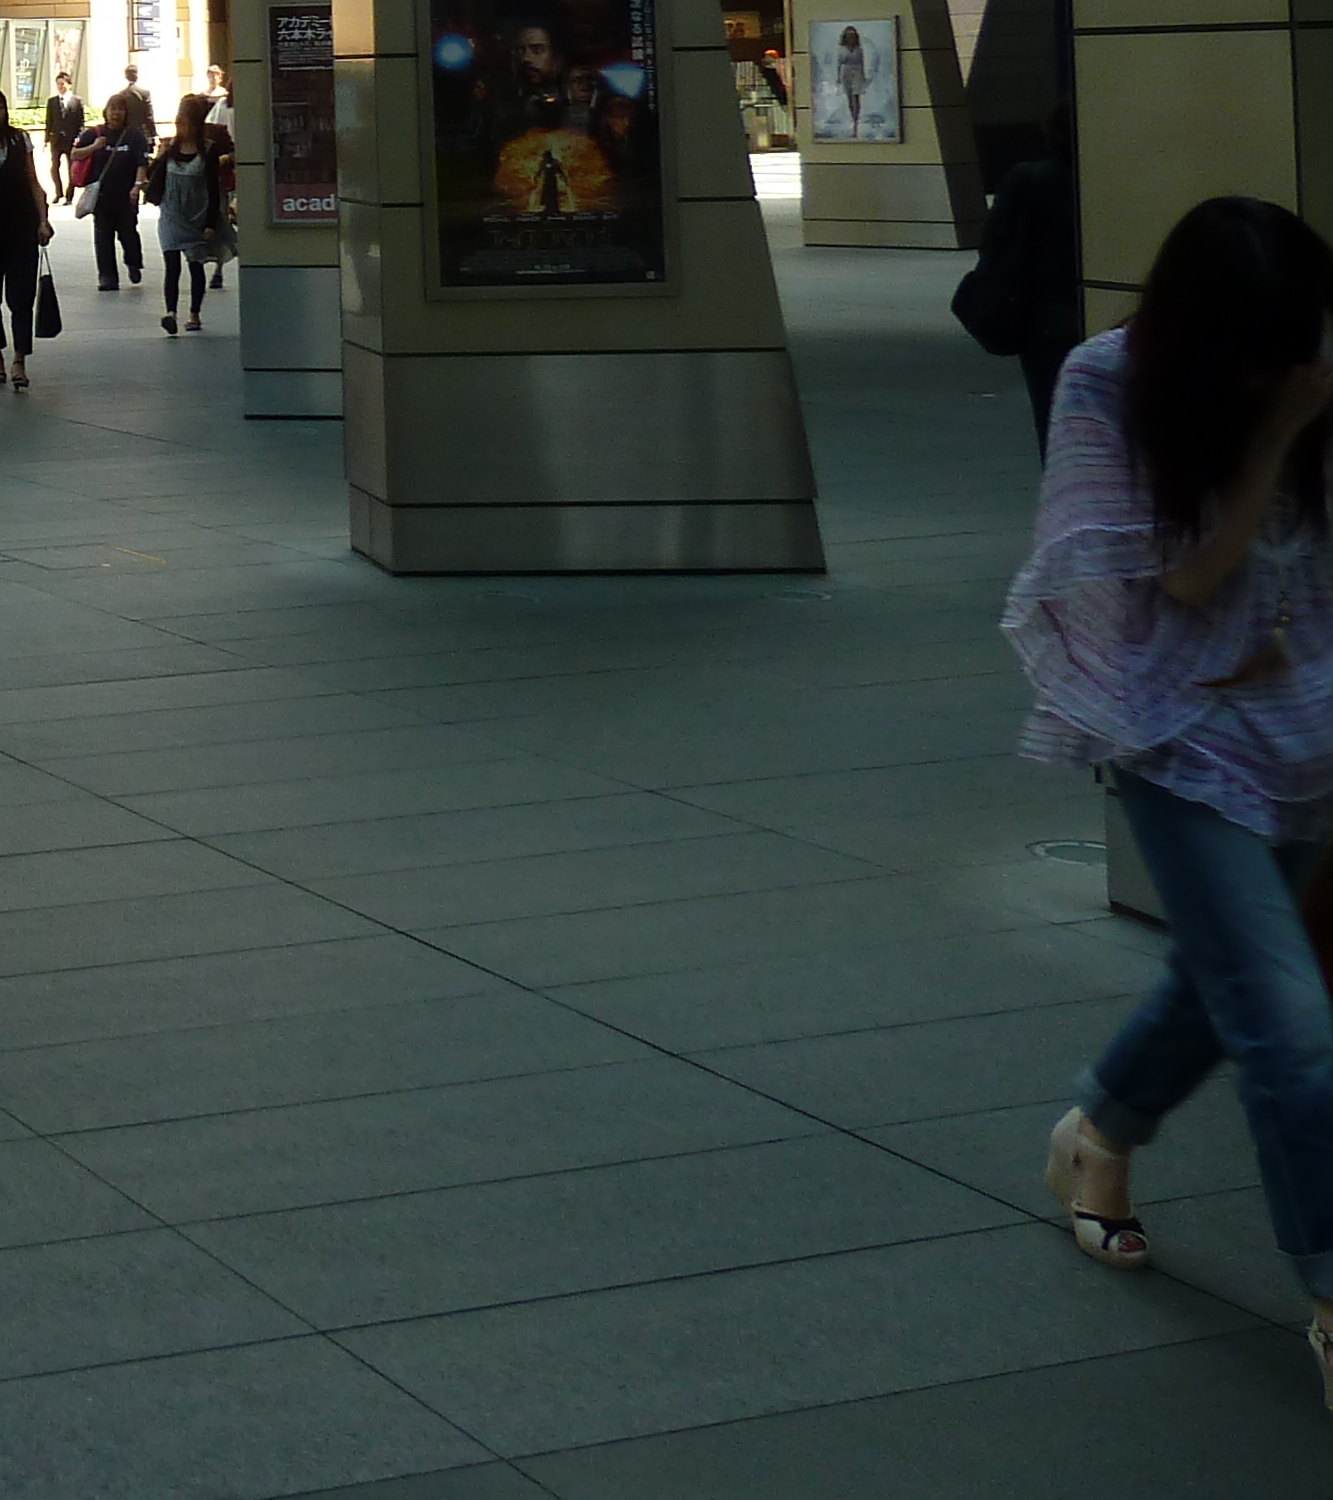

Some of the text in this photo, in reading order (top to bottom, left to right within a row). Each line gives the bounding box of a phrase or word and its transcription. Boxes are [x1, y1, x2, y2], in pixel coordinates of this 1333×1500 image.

[276, 15, 331, 28] アカデミー
[282, 194, 337, 213] acad
